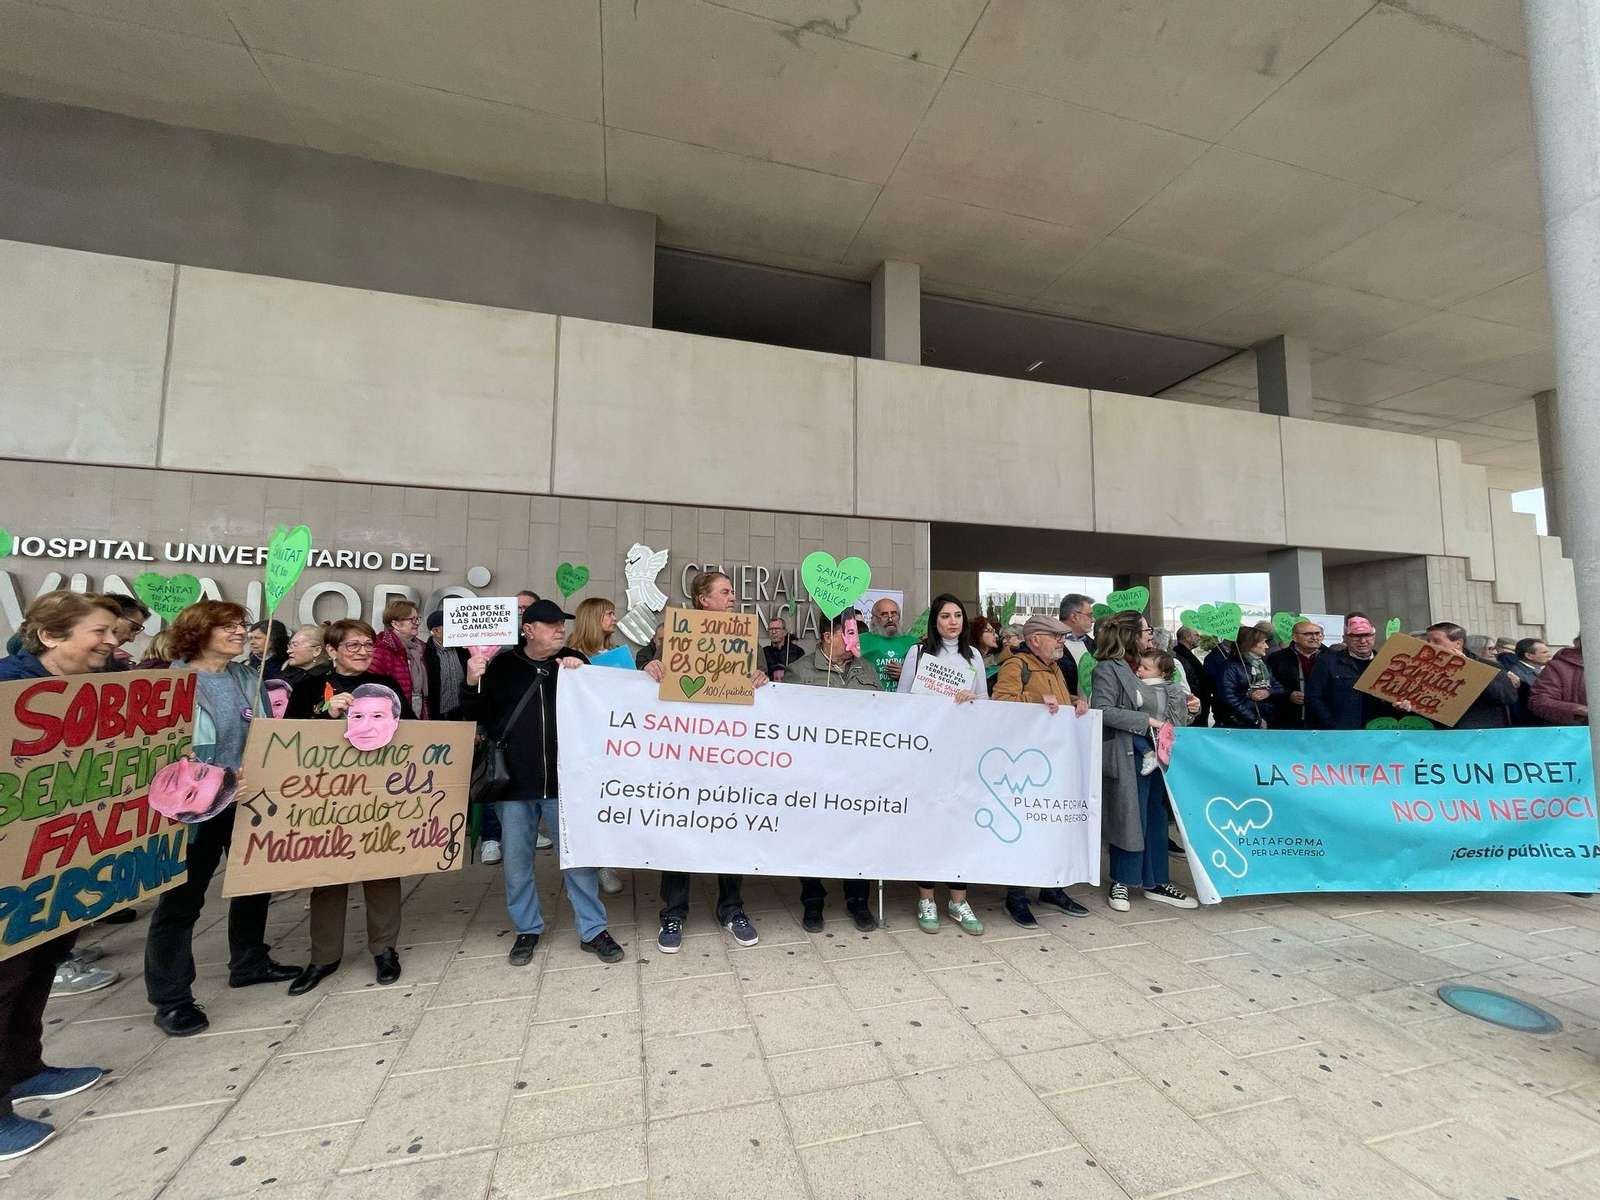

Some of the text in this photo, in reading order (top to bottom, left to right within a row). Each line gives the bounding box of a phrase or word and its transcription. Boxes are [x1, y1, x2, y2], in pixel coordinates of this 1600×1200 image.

[164, 541, 383, 570] UNIVERTARIO
[390, 552, 440, 572] DEL
[837, 583, 850, 592] 100
[461, 623, 499, 631] CAMAS?
[471, 616, 509, 624] NUEVAS
[673, 611, 692, 633] La
[700, 615, 752, 637] sanitat
[668, 636, 693, 652] no
[696, 637, 716, 653] es
[670, 652, 754, 683] es defen!
[925, 665, 966, 684] TERRENY PER
[929, 661, 939, 670] ON
[937, 675, 960, 687] SEGON
[11, 673, 198, 757] SOBREN
[608, 711, 933, 753] LA SANIDAD ES UN DERECHO,
[422, 743, 453, 766] on
[605, 739, 793, 769] NO UN NEGOCIO
[280, 762, 434, 799] estan els
[1254, 758, 1582, 786] LA SANITAT ÉS UN DRET,
[286, 790, 446, 828] indicadors?
[600, 779, 908, 816] ¡Gestión pública del Hospital
[1391, 796, 1596, 823] NO UN NEGOCI
[597, 806, 779, 833] del Vinalopó YA!
[1026, 812, 1048, 822] POR
[1050, 814, 1063, 823] LA
[243, 824, 356, 866] Matarile,
[1238, 837, 1323, 847] PLATAFORMA
[1252, 849, 1267, 857] PER
[1281, 848, 1325, 857] REVERSIÓ
[1450, 845, 1504, 861] ¡Gestió
[1507, 843, 1576, 861] pública
[0, 829, 188, 946] PERSONAL
